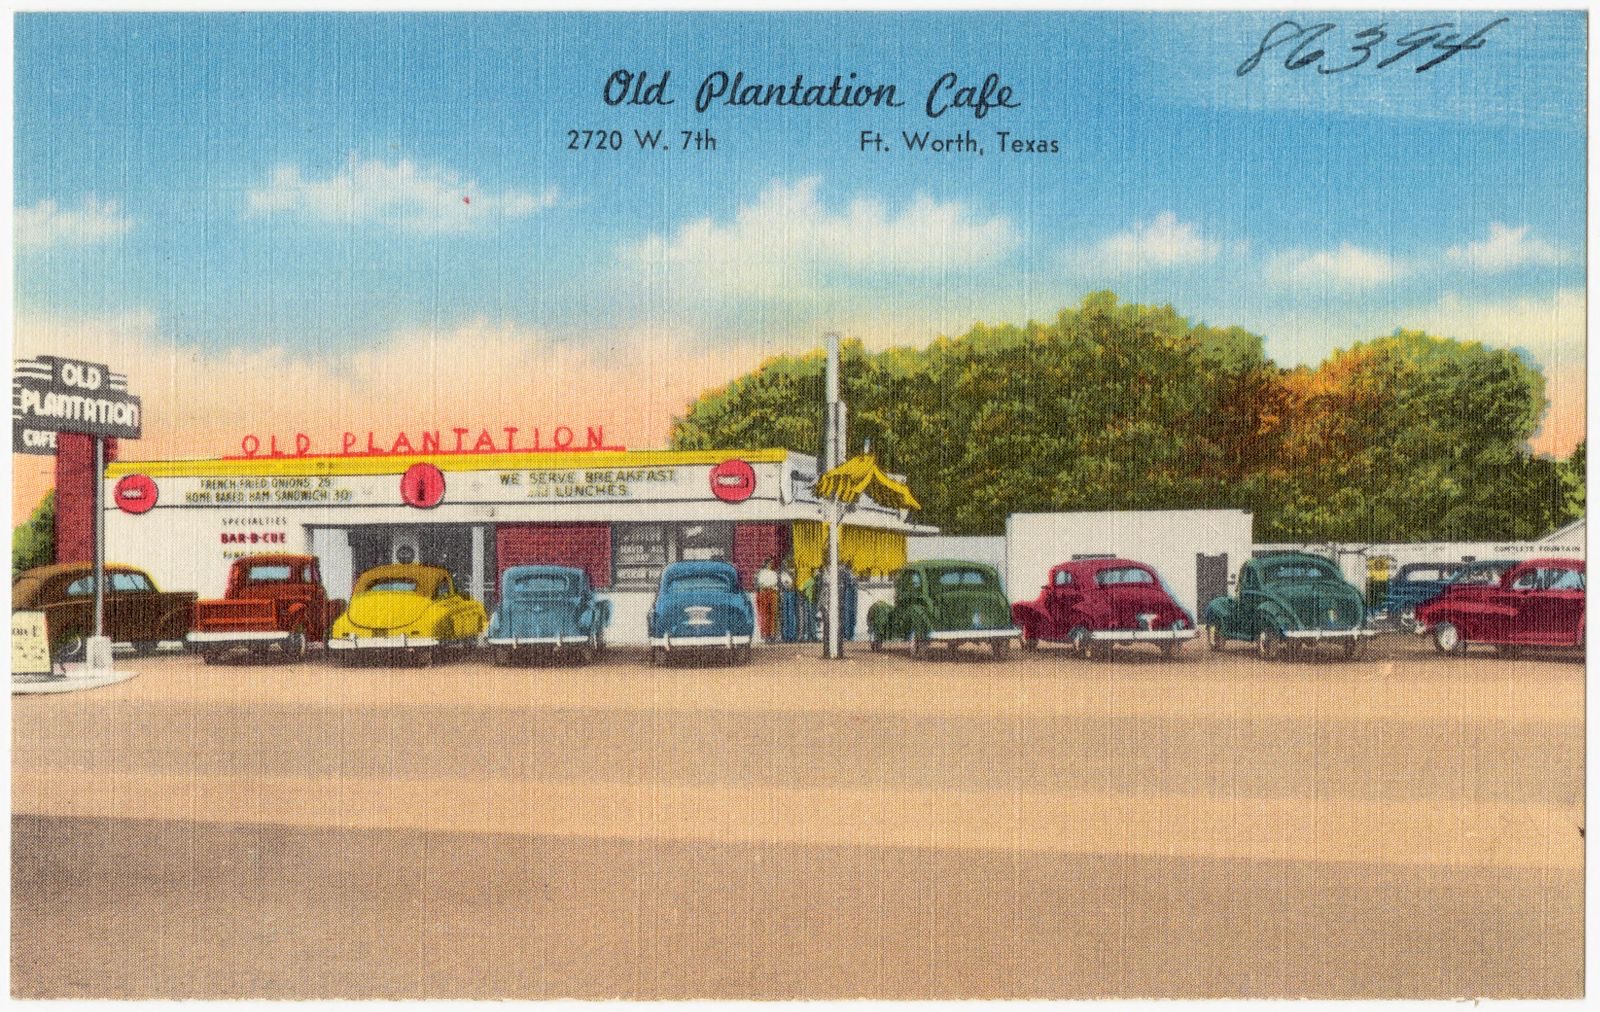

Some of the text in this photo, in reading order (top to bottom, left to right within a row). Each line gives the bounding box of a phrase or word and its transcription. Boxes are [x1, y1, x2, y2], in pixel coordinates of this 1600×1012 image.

[60, 362, 102, 391] OLD
[20, 387, 140, 428] PLANTATION
[240, 427, 602, 457] OLD PLANTATION
[200, 478, 237, 490] FRENCH
[271, 477, 310, 489] ONIONS
[499, 469, 676, 485] WE SERVE BREAKFAST
[274, 489, 328, 501] SANDWICH
[222, 516, 287, 526] SPECIALTIES
